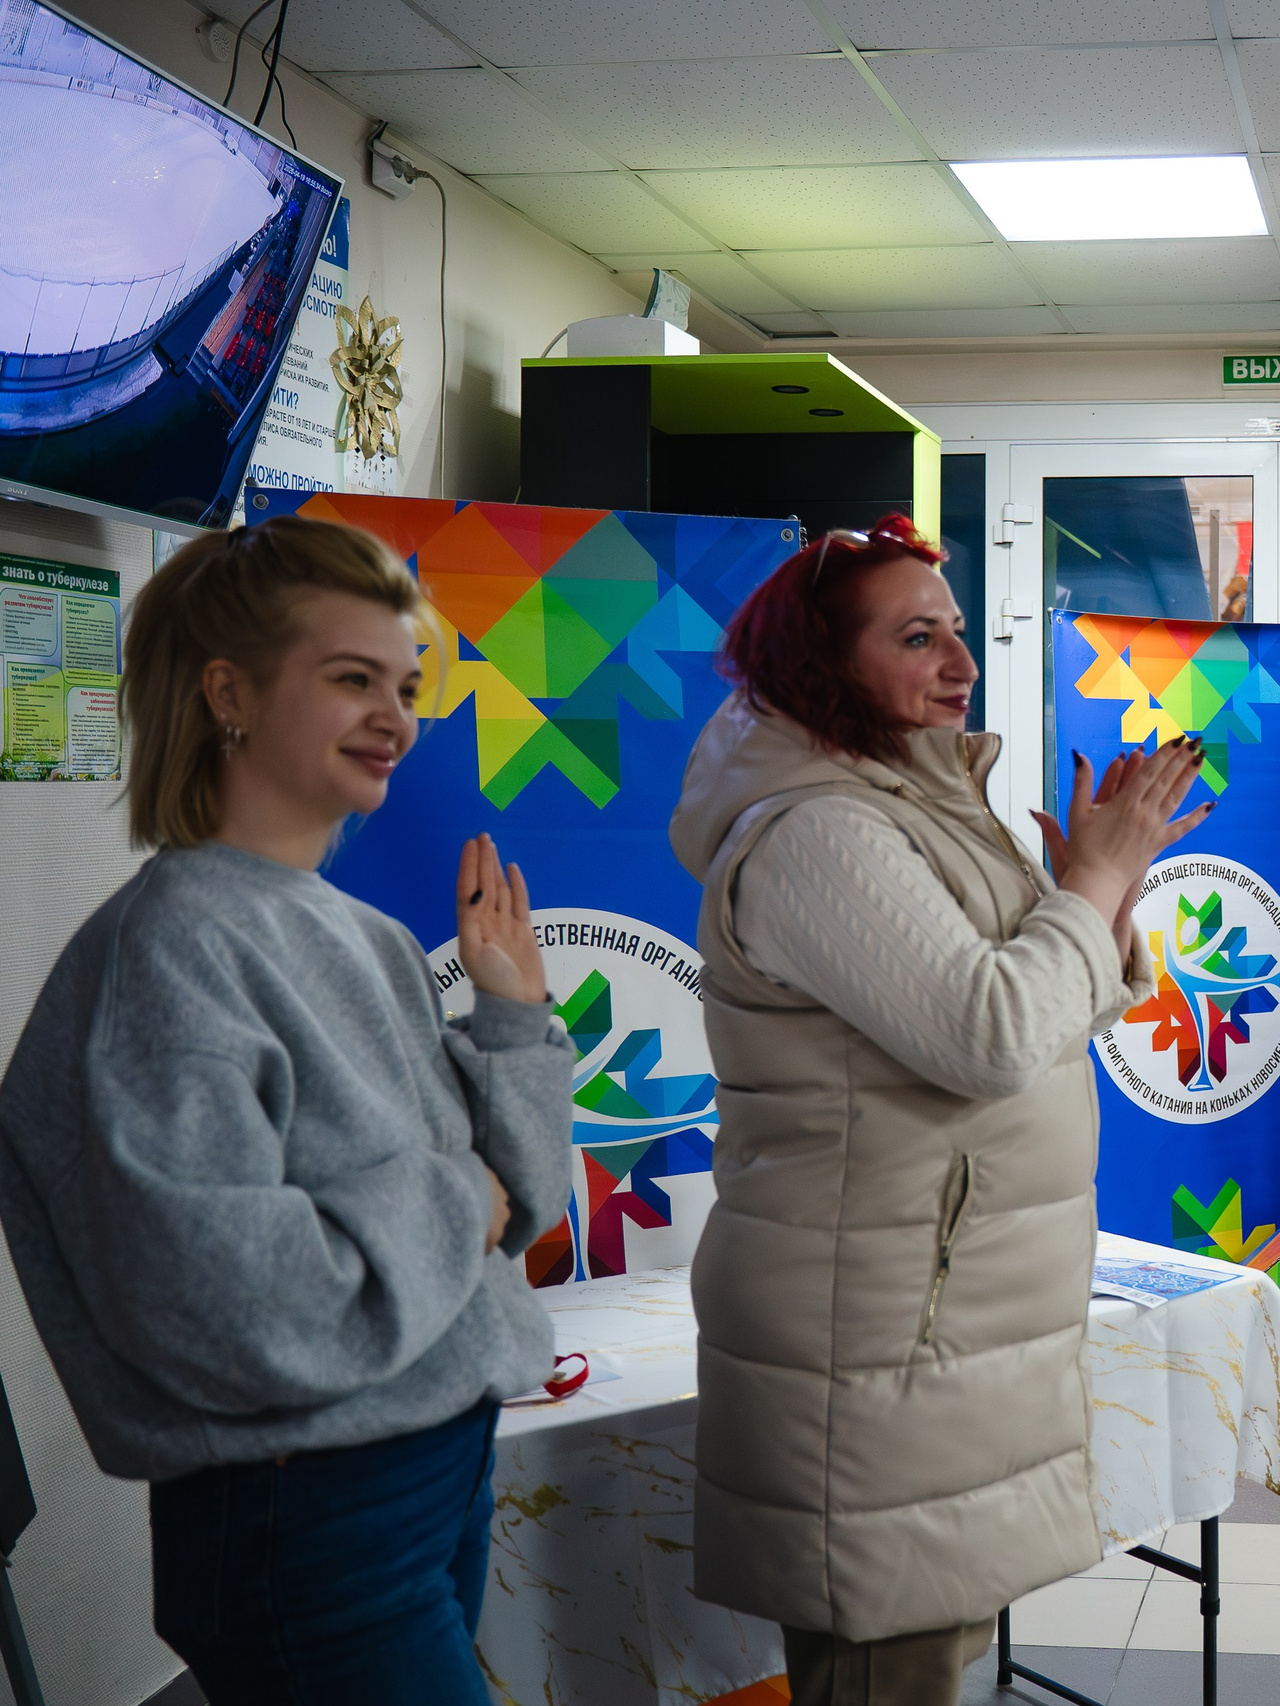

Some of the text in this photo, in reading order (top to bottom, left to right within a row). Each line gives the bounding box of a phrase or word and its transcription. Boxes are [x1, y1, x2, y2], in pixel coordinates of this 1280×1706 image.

[310, 273, 342, 299] АЦИЮ
[289, 343, 314, 359] ИЧЕСКИХ
[262, 421, 279, 434] ЛИСА
[2, 566, 109, 592] знать о туберкулезе
[1161, 862, 1238, 884] ОБЩЕСТВЕННАЯ
[533, 923, 703, 1002] ЕСТВЕННАЯ ОРГАНИ
[1107, 1042, 1152, 1098] ФИГУРНОГО
[1149, 1089, 1193, 1115] КАТАНИЯ
[1195, 1101, 1208, 1115] НА
[1209, 1083, 1253, 1112] КОНЬКАХ
